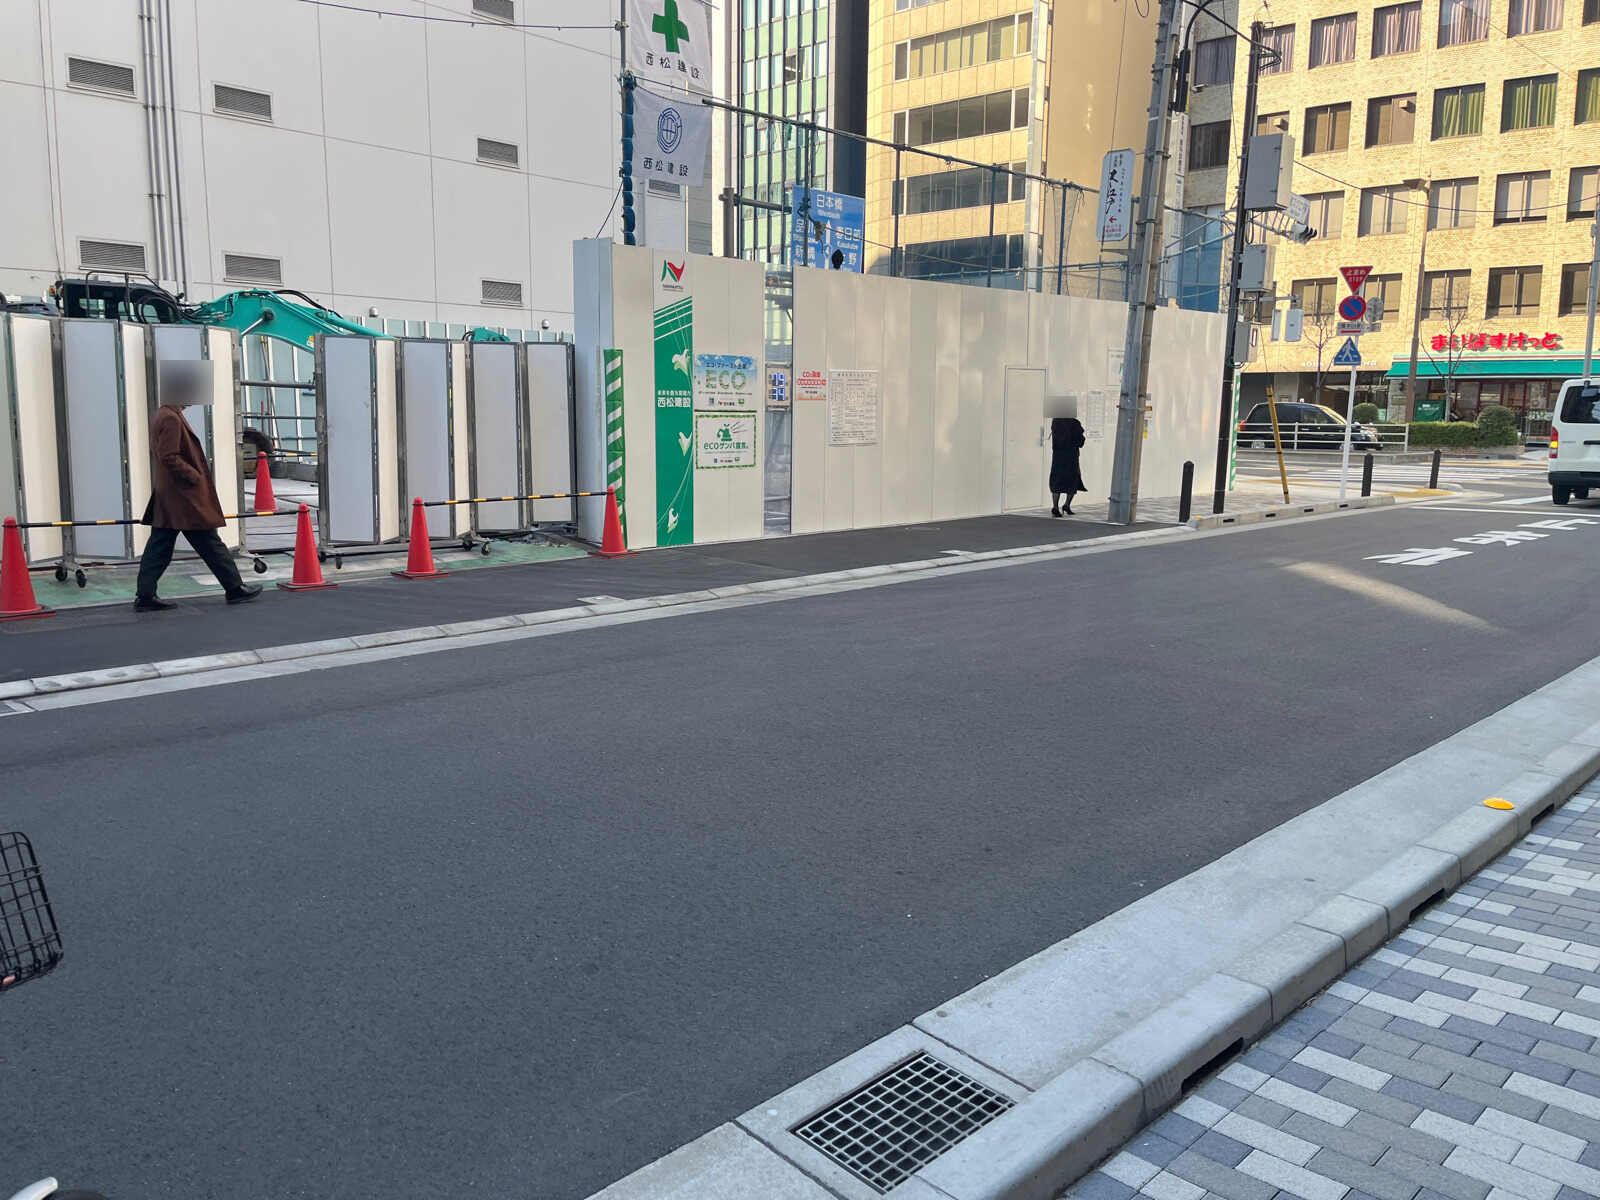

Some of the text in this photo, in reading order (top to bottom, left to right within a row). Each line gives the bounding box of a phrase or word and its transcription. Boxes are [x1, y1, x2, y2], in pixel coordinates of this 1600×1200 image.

[646, 52, 700, 79] 西松建設
[643, 157, 688, 177] 西松建設
[816, 194, 843, 211] 日本橋
[1431, 332, 1560, 351] まいばすけっと
[705, 370, 746, 390] ECO
[657, 397, 691, 408] 西松建設
